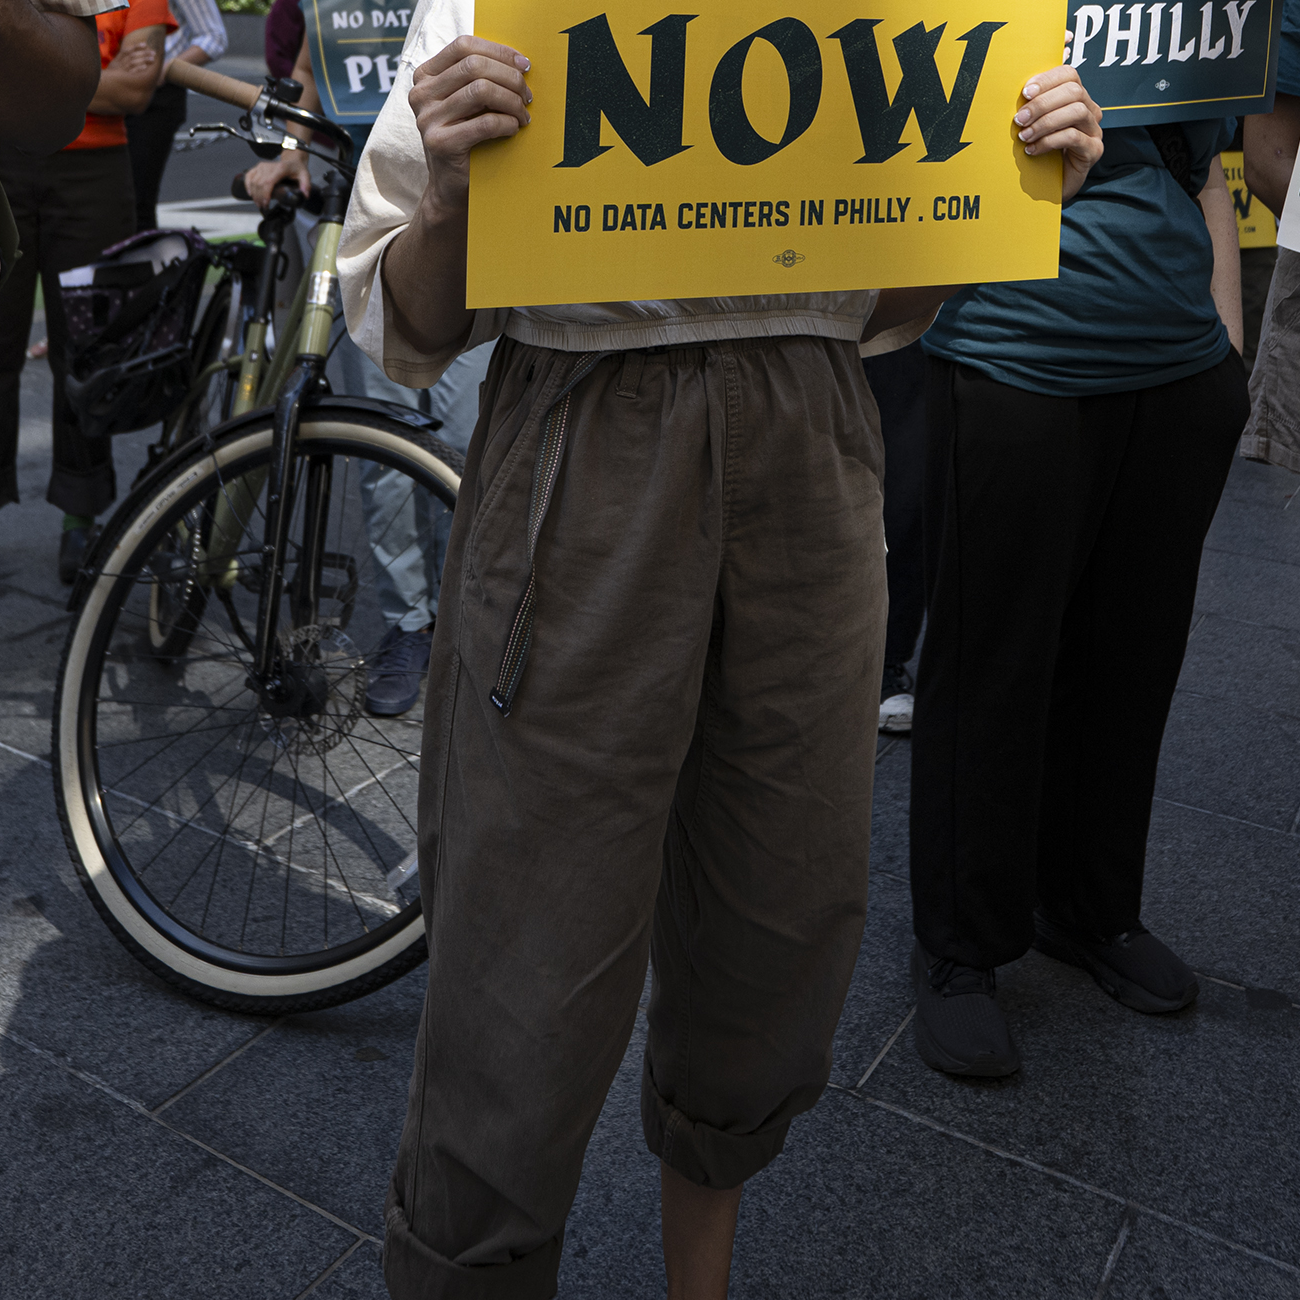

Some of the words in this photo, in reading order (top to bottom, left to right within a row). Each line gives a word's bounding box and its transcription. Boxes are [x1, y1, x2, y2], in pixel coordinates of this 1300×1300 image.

[332, 10, 364, 29] NO
[371, 9, 412, 28] DAT
[1069, 0, 1258, 69] PHILLY
[552, 12, 1010, 169] NOW
[552, 204, 591, 234] NO
[602, 203, 667, 232] DATA
[677, 200, 791, 230] CENTERS
[799, 199, 824, 226] IN
[834, 196, 911, 225] PHILLY
